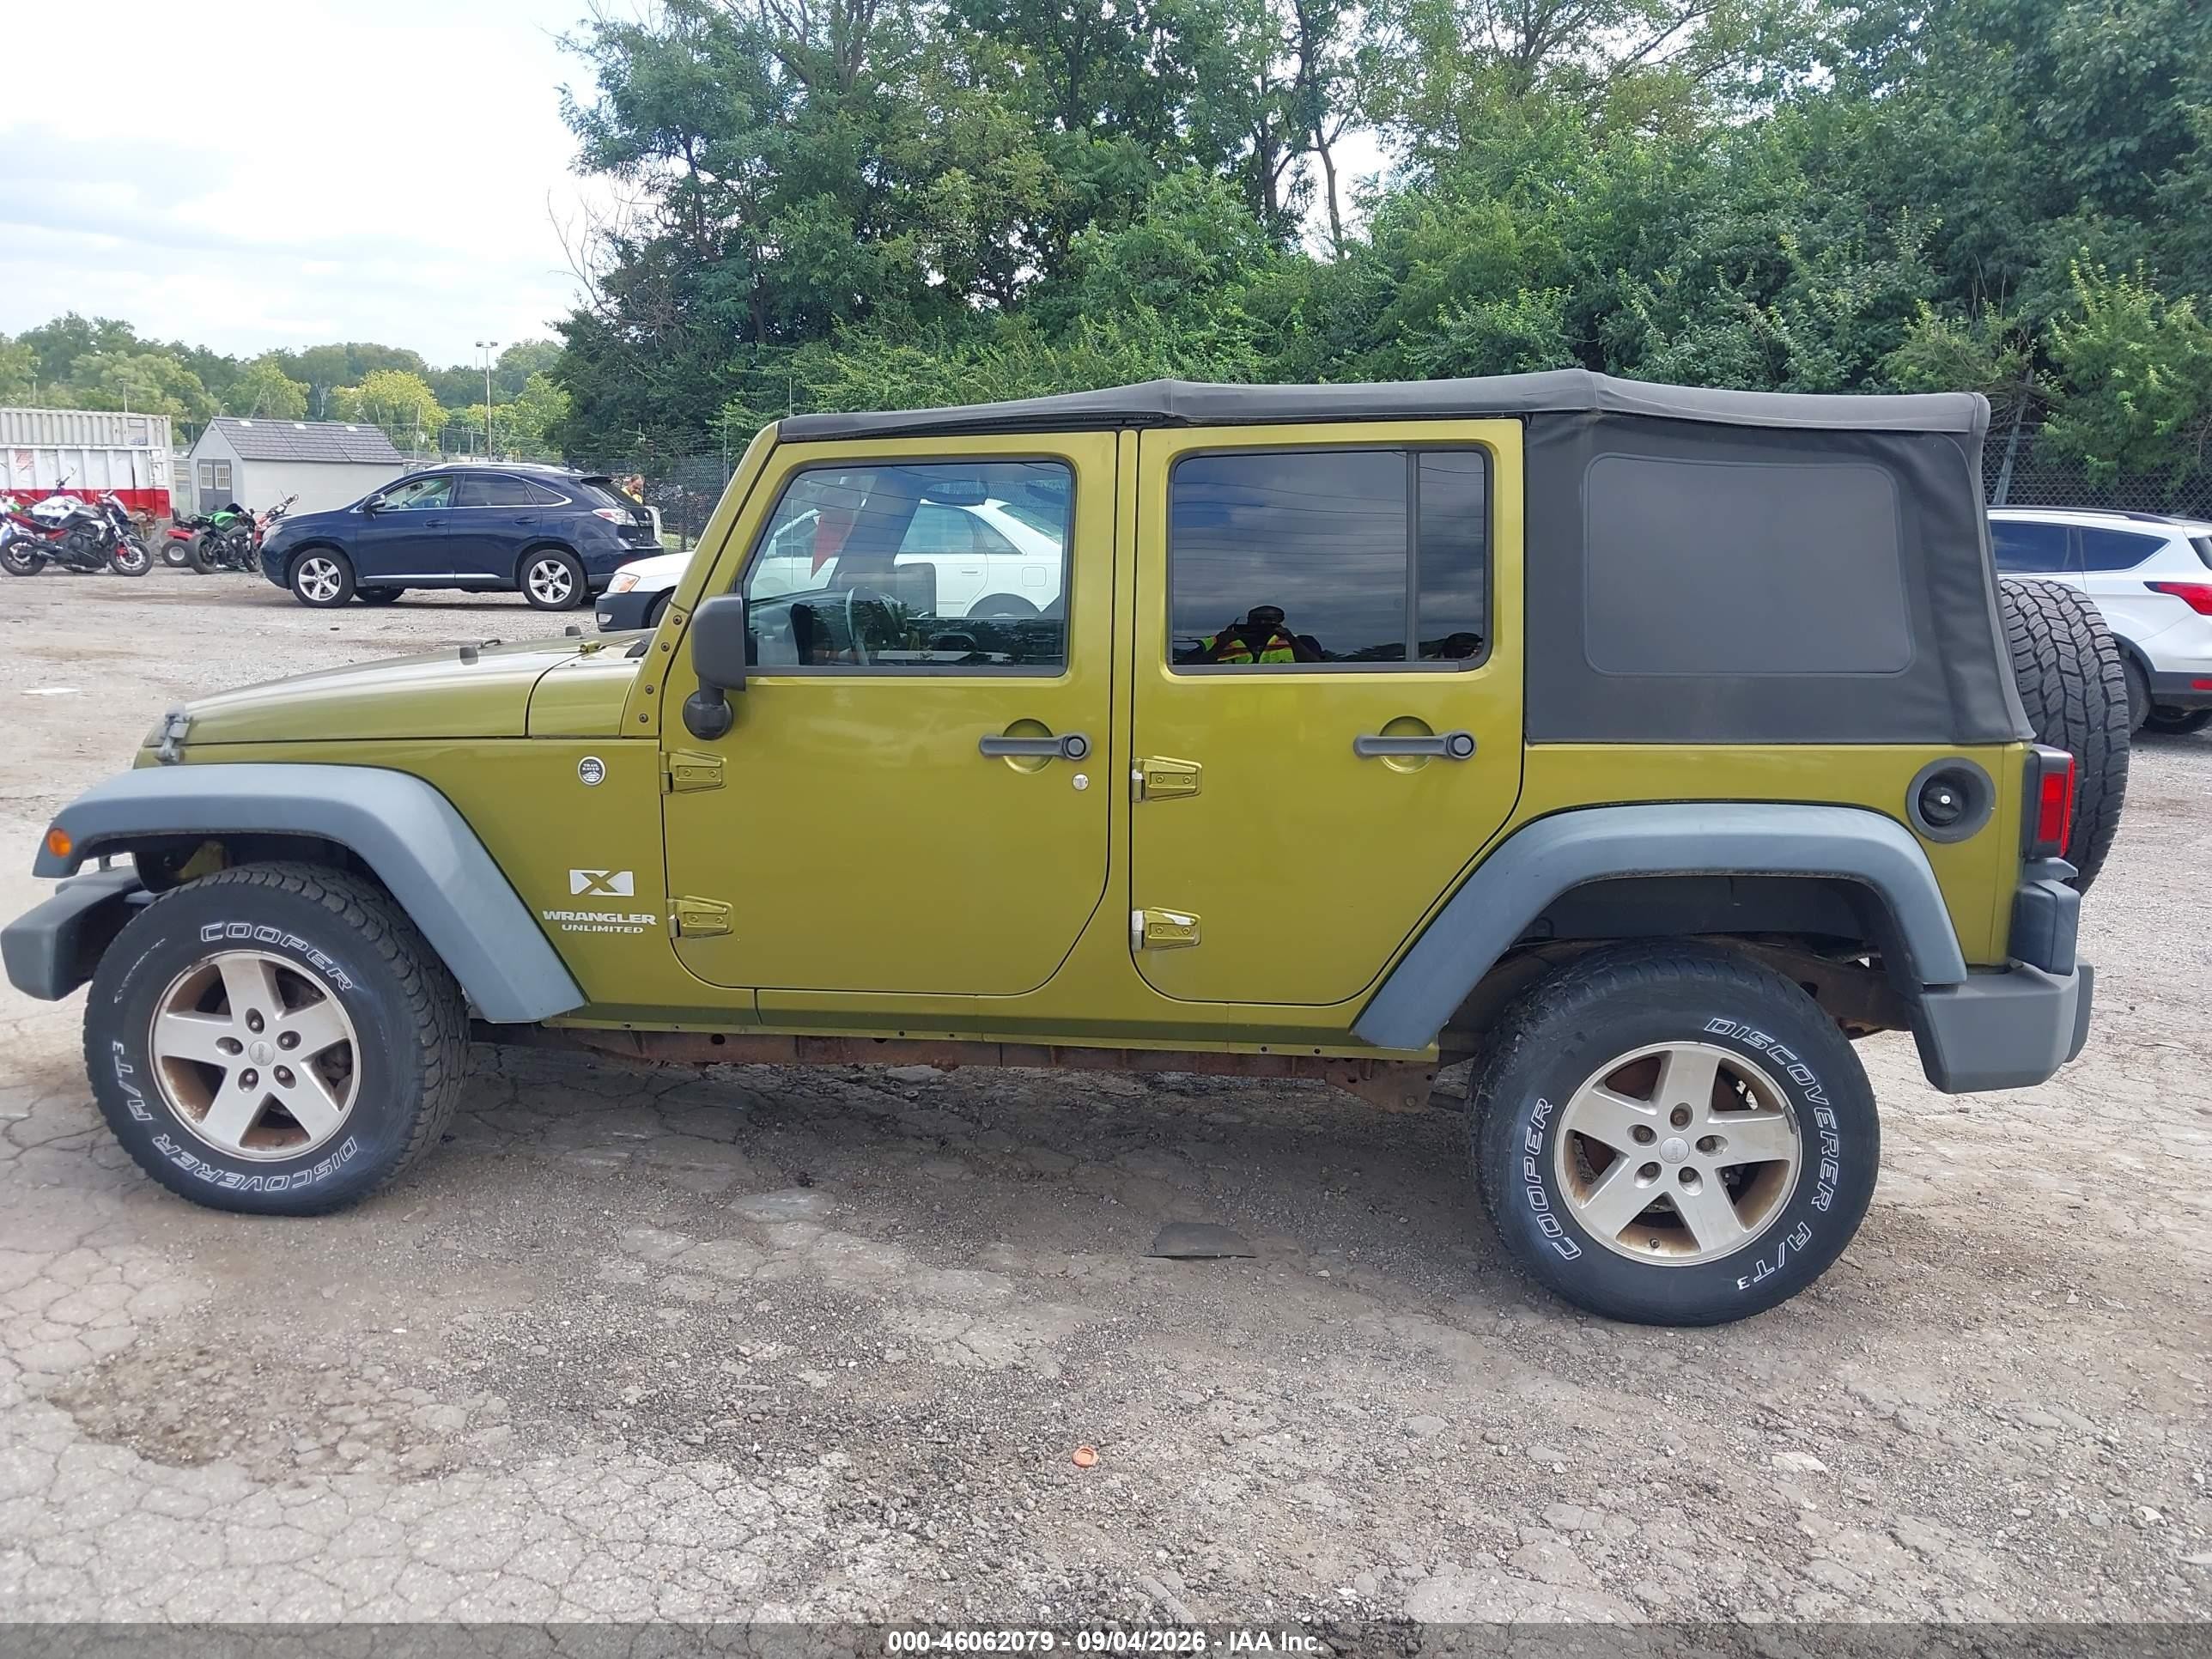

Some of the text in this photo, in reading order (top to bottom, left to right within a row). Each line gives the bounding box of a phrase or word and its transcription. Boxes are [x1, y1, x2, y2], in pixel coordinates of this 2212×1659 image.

[543, 910, 657, 926] WRANGLER
[562, 924, 644, 934] UNLIMITED
[200, 922, 355, 991] COOPER
[1704, 1017, 1840, 1212] DISCOVERER
[153, 1132, 358, 1192] DISCOVERER
[1522, 1097, 1583, 1261] COOPER
